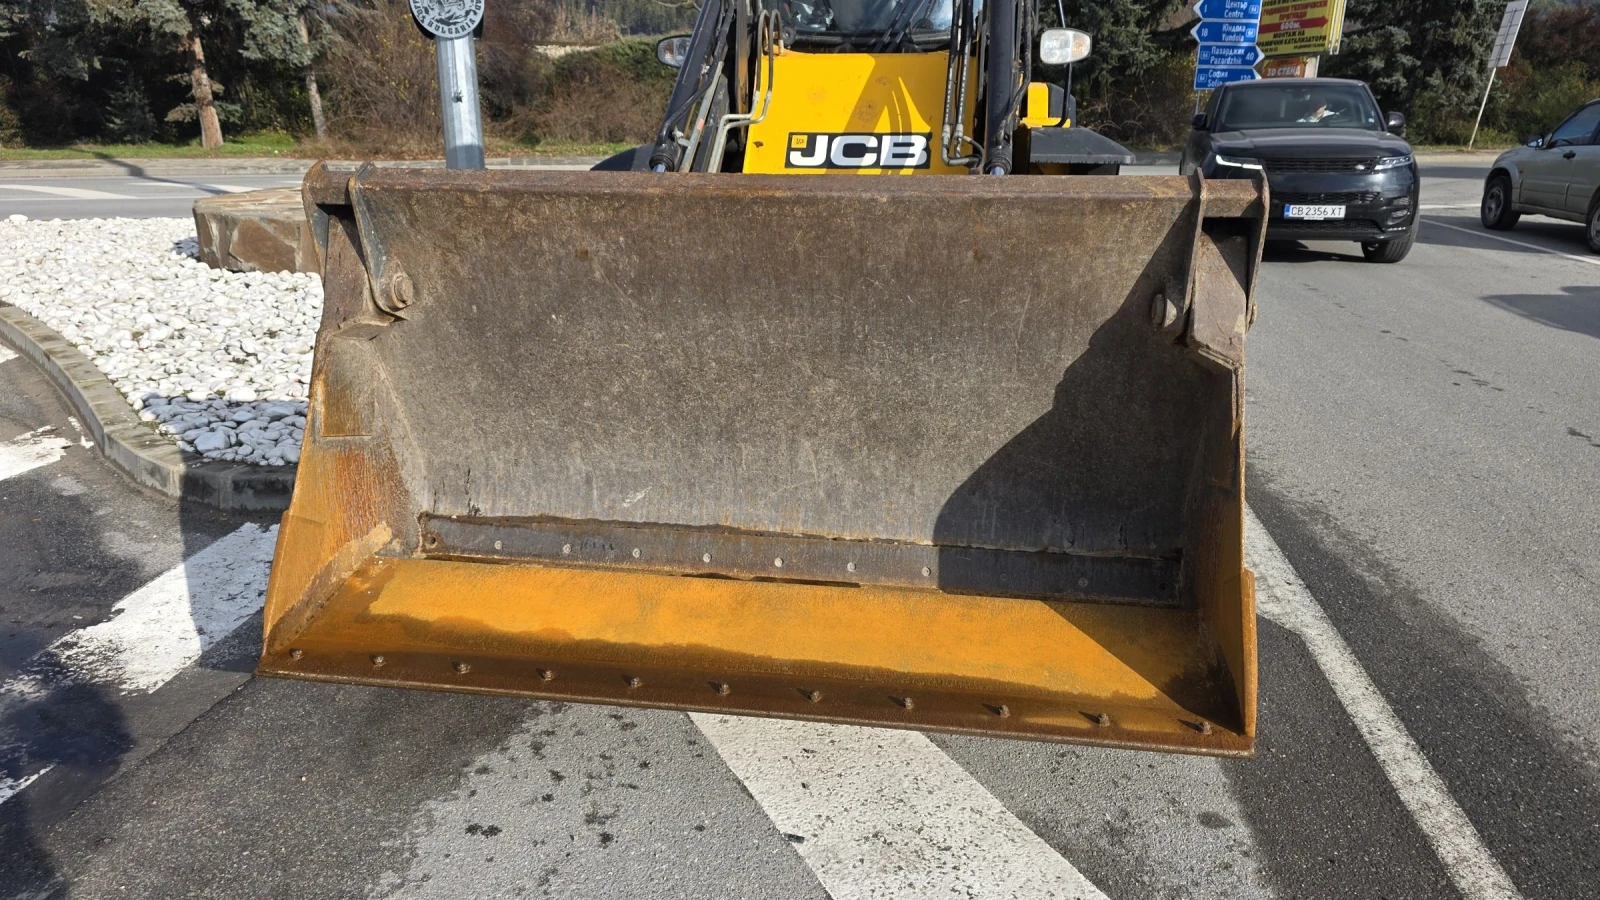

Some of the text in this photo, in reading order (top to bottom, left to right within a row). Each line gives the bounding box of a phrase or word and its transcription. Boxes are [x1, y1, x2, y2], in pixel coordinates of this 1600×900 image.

[1224, 9, 1244, 18] Centre
[427, 18, 476, 35] BULGARIA
[1201, 23, 1246, 37] 18 Юндола
[1222, 33, 1245, 42] Yundola
[1273, 29, 1305, 39] МОНТАЖ НА
[1284, 35, 1327, 45] КАТАЛИЗАТОРИ
[1211, 46, 1245, 56] Пазарджик
[1245, 52, 1255, 60] 40
[1210, 56, 1243, 64] Pazardzhik
[1208, 70, 1229, 78] София
[789, 135, 928, 166] JCB
[1291, 206, 1343, 216] CB 2356 XT
